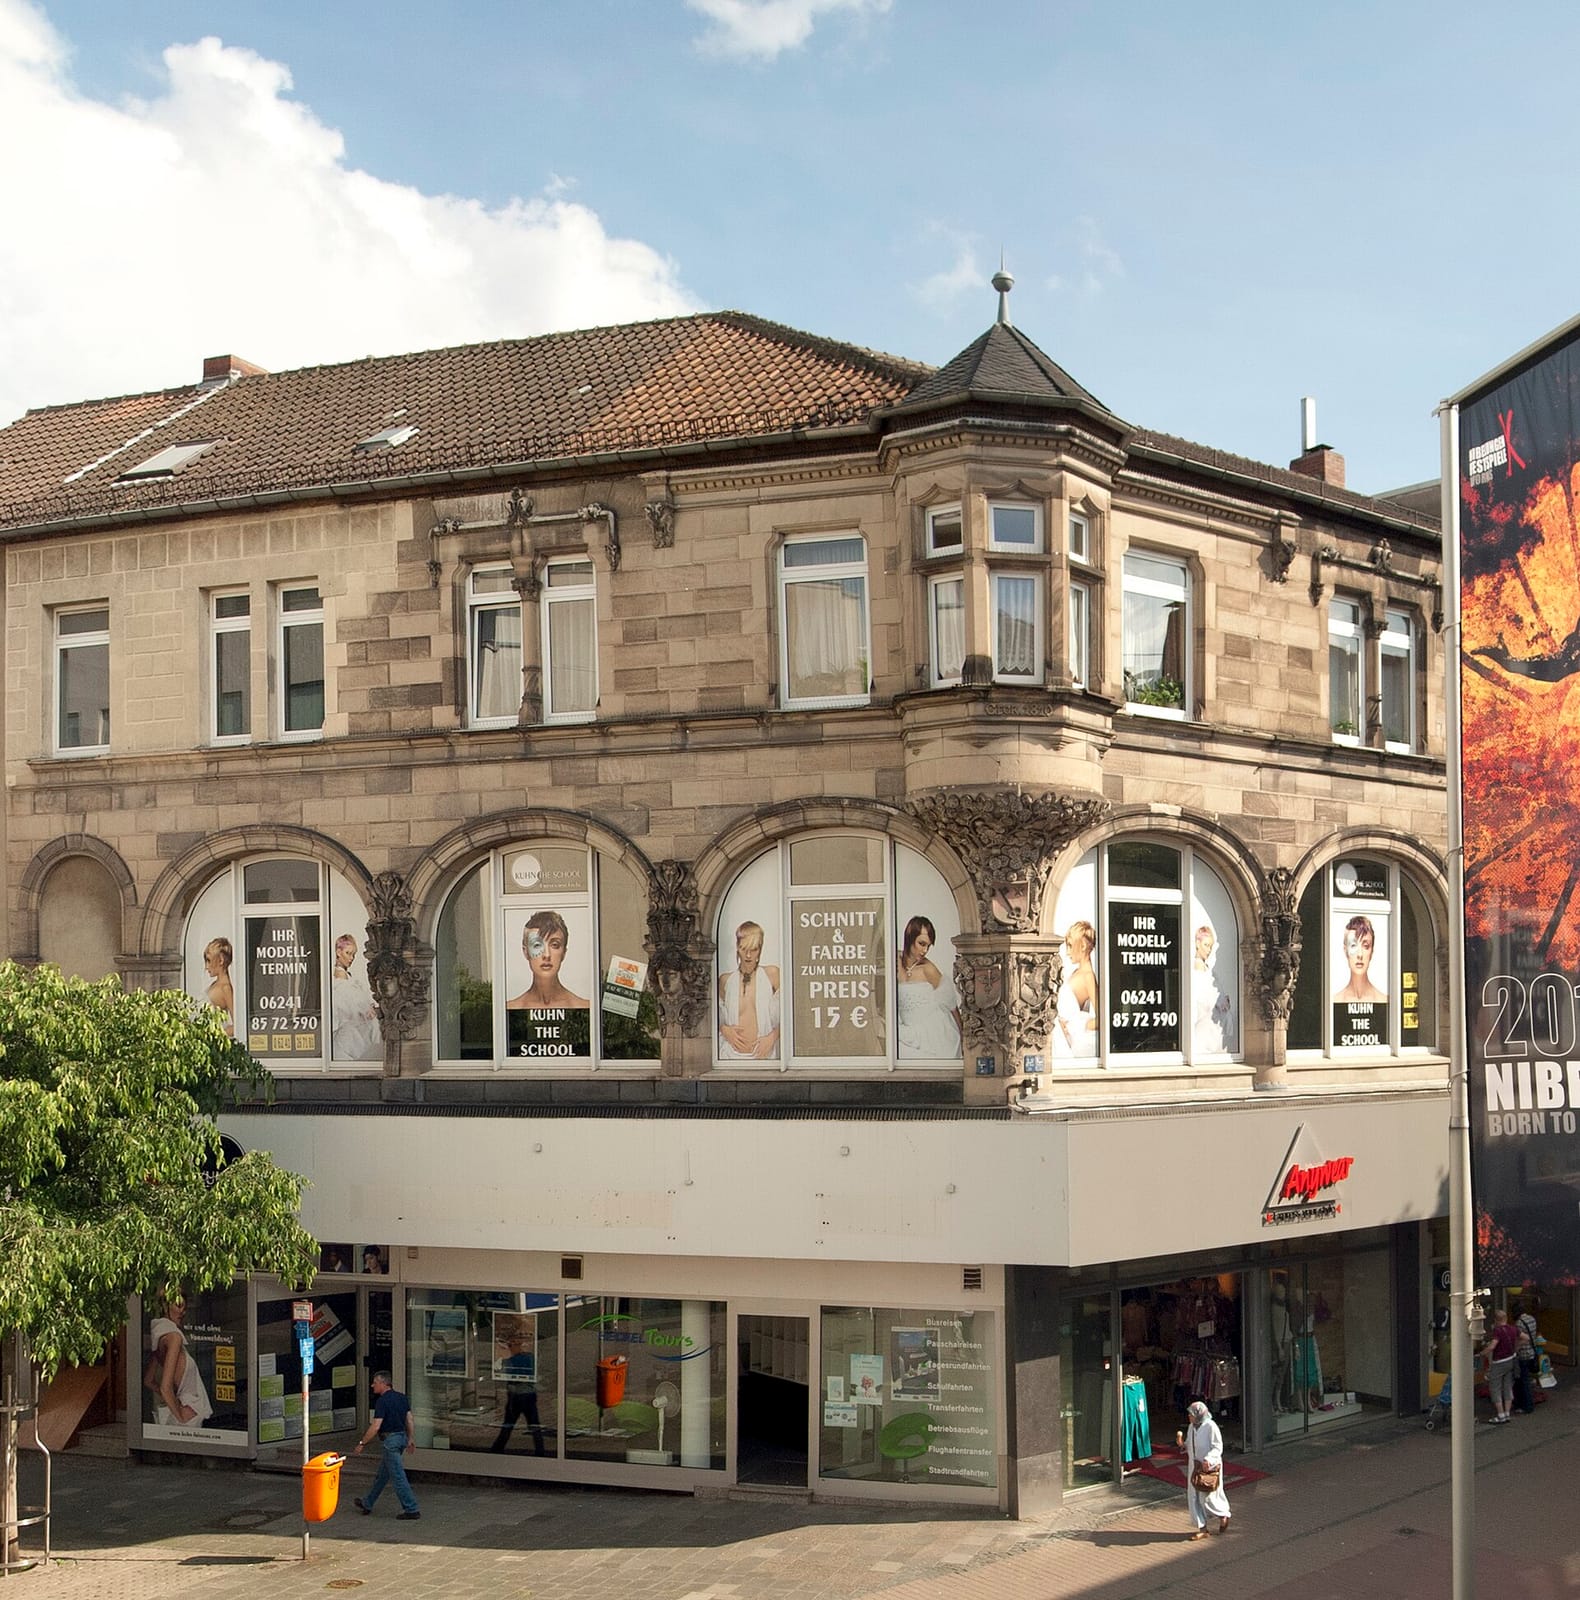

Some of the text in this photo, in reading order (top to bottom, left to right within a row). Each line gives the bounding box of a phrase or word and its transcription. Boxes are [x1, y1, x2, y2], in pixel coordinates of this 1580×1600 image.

[800, 912, 877, 928] SCHNITT
[1133, 917, 1156, 930] IHR
[272, 930, 295, 941] IHR
[832, 928, 845, 943] &
[1117, 934, 1172, 948] MODELL-
[256, 946, 311, 959] MODELL-
[811, 945, 866, 960] FARBE
[1121, 952, 1167, 965] TERMIN
[260, 963, 307, 975] TERMIN
[801, 965, 877, 976] ZUM KLEINEN
[810, 981, 870, 999] PREIS
[260, 996, 301, 1009] 06241
[1121, 990, 1162, 1005] 06241
[530, 1009, 565, 1021] KUHN
[1347, 1003, 1374, 1015] KUHN
[811, 1006, 868, 1028] 15 €
[1113, 1012, 1178, 1027] 85 72 590
[1482, 973, 1580, 1058] 20
[252, 1016, 318, 1030] 85 72 590
[1351, 1019, 1370, 1030] THE
[534, 1027, 560, 1038] THE
[1341, 1034, 1380, 1046] SCHOOL
[520, 1044, 576, 1056] SCHOOL
[1488, 1111, 1577, 1137] BORN TO
[926, 1318, 963, 1328] Busreisen
[644, 1328, 693, 1347] Tours
[926, 1340, 982, 1350] Pauschalreisen
[928, 1360, 992, 1371] Tagesrundfahrten
[927, 1382, 974, 1392] Schulfahrten
[928, 1403, 984, 1413] Transferfahrten
[927, 1424, 989, 1436] Betriebsausflüge
[928, 1445, 993, 1456] Flughafentransfer
[928, 1466, 990, 1478] Stadtrundfahrten
